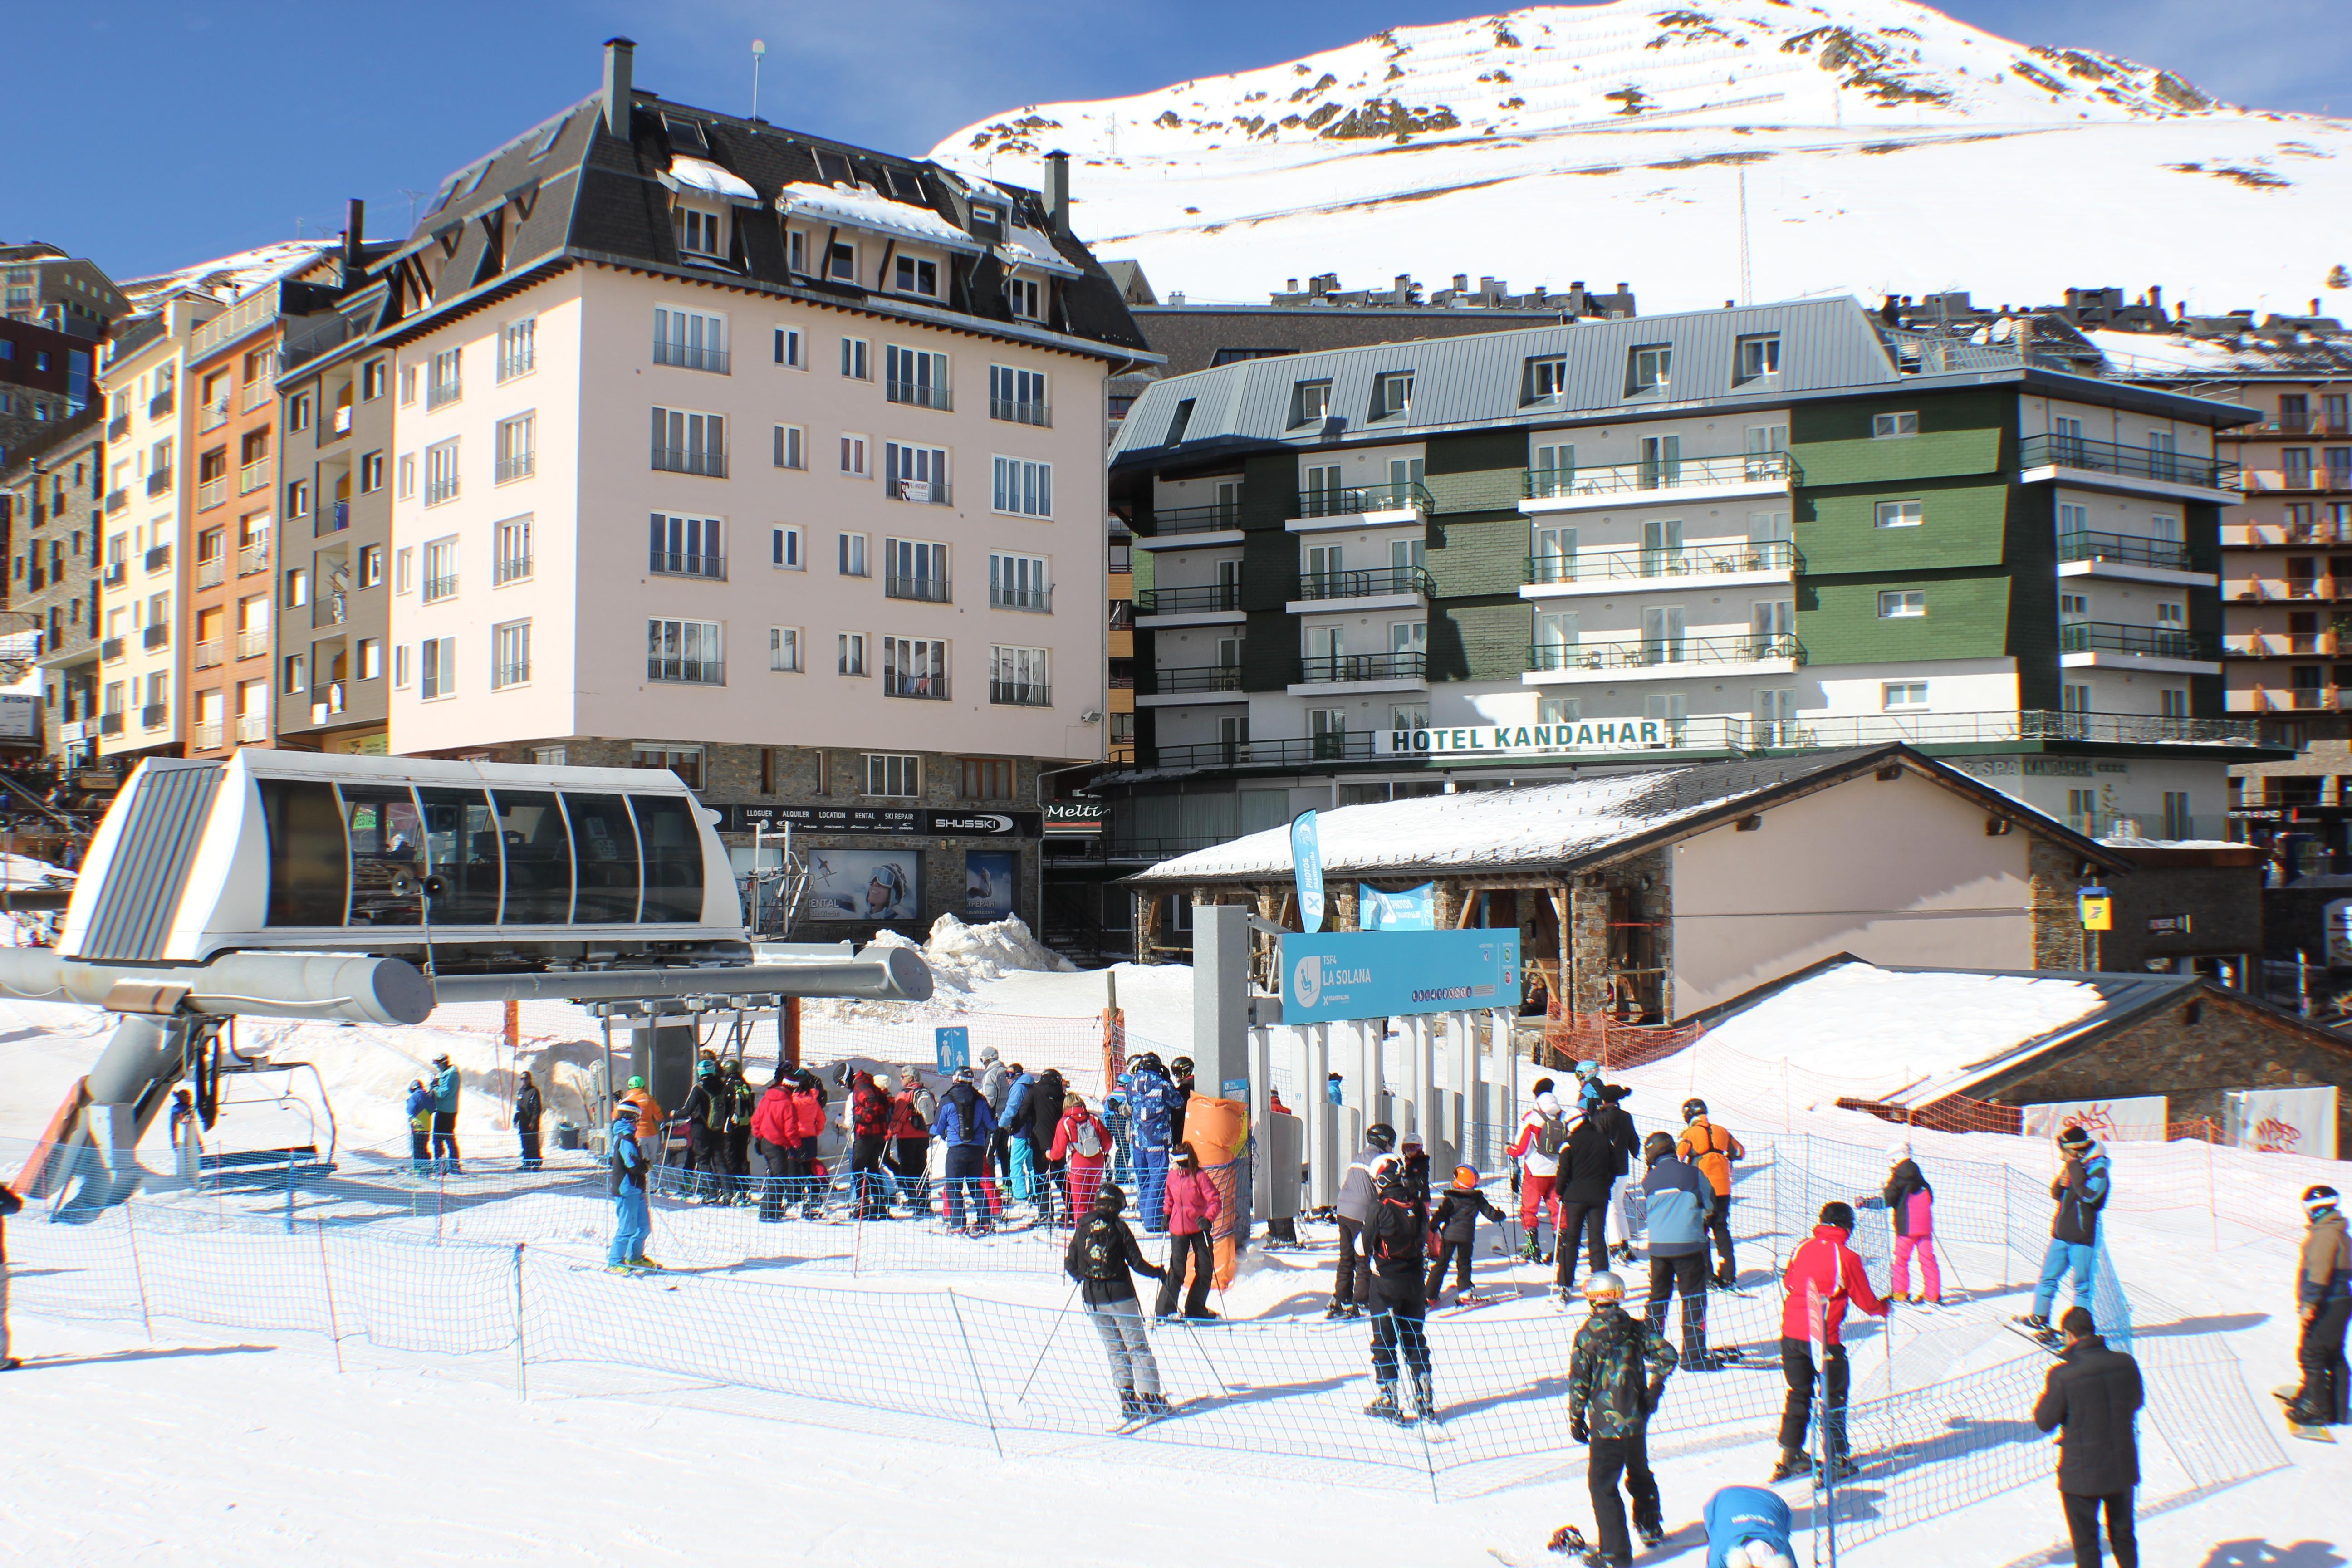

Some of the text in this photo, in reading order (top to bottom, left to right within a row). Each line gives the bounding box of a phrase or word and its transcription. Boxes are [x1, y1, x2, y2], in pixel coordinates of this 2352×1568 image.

[1392, 721, 1658, 751] HOTEL KANDAHAR
[1982, 761, 2019, 776] SPA
[2024, 761, 2095, 777] KANDAHAR
[1047, 804, 1102, 818] Melti
[935, 818, 995, 828] SHUSSKI
[1302, 858, 1313, 889] PHOTOS
[1309, 850, 1319, 890] GRANDVALIRA
[1323, 955, 1337, 965] TSF4
[1323, 968, 1372, 986] LA SOLANA
